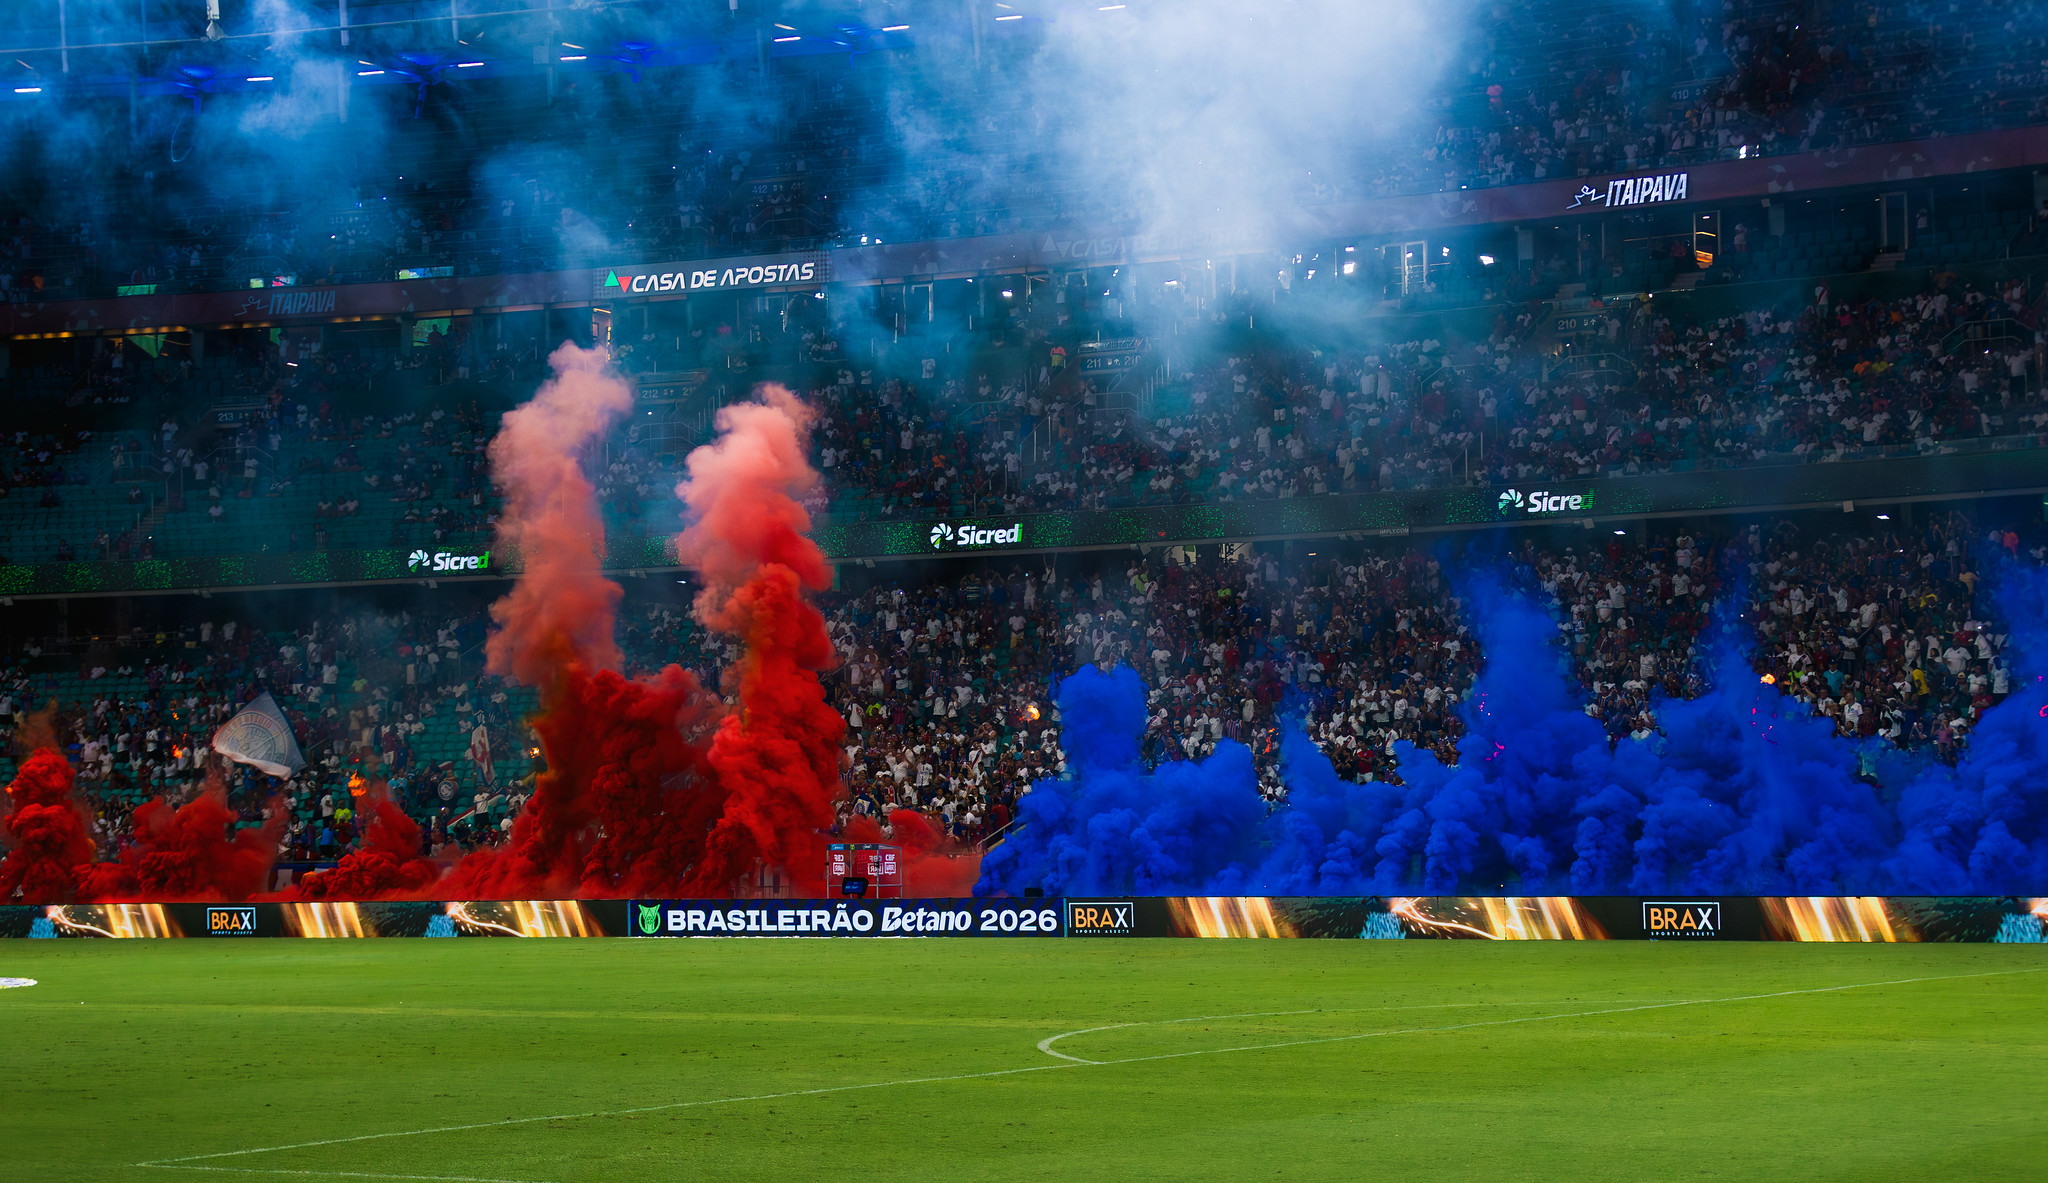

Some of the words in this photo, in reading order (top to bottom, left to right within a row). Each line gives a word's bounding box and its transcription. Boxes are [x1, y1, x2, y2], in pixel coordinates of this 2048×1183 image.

[1671, 89, 1689, 100] 410
[752, 184, 768, 194] 412
[1605, 173, 1688, 207] ITAIPAVA
[632, 272, 686, 293] CASA
[690, 269, 718, 289] DE
[719, 262, 815, 287] APOSTAS
[268, 291, 335, 314] ITAIPAVA
[1558, 318, 1577, 331] 210
[1086, 358, 1101, 369] 211
[641, 389, 658, 398] 212
[217, 412, 234, 422] 213
[957, 522, 1023, 546] Sicredi
[432, 551, 490, 571] Sicred
[211, 911, 252, 930] BRAX
[667, 903, 874, 932] BRASILEIRÃO
[881, 906, 972, 932] Betano
[979, 909, 1057, 932] 2026
[1074, 907, 1129, 928] BRAX
[1650, 907, 1714, 930] BRAX
